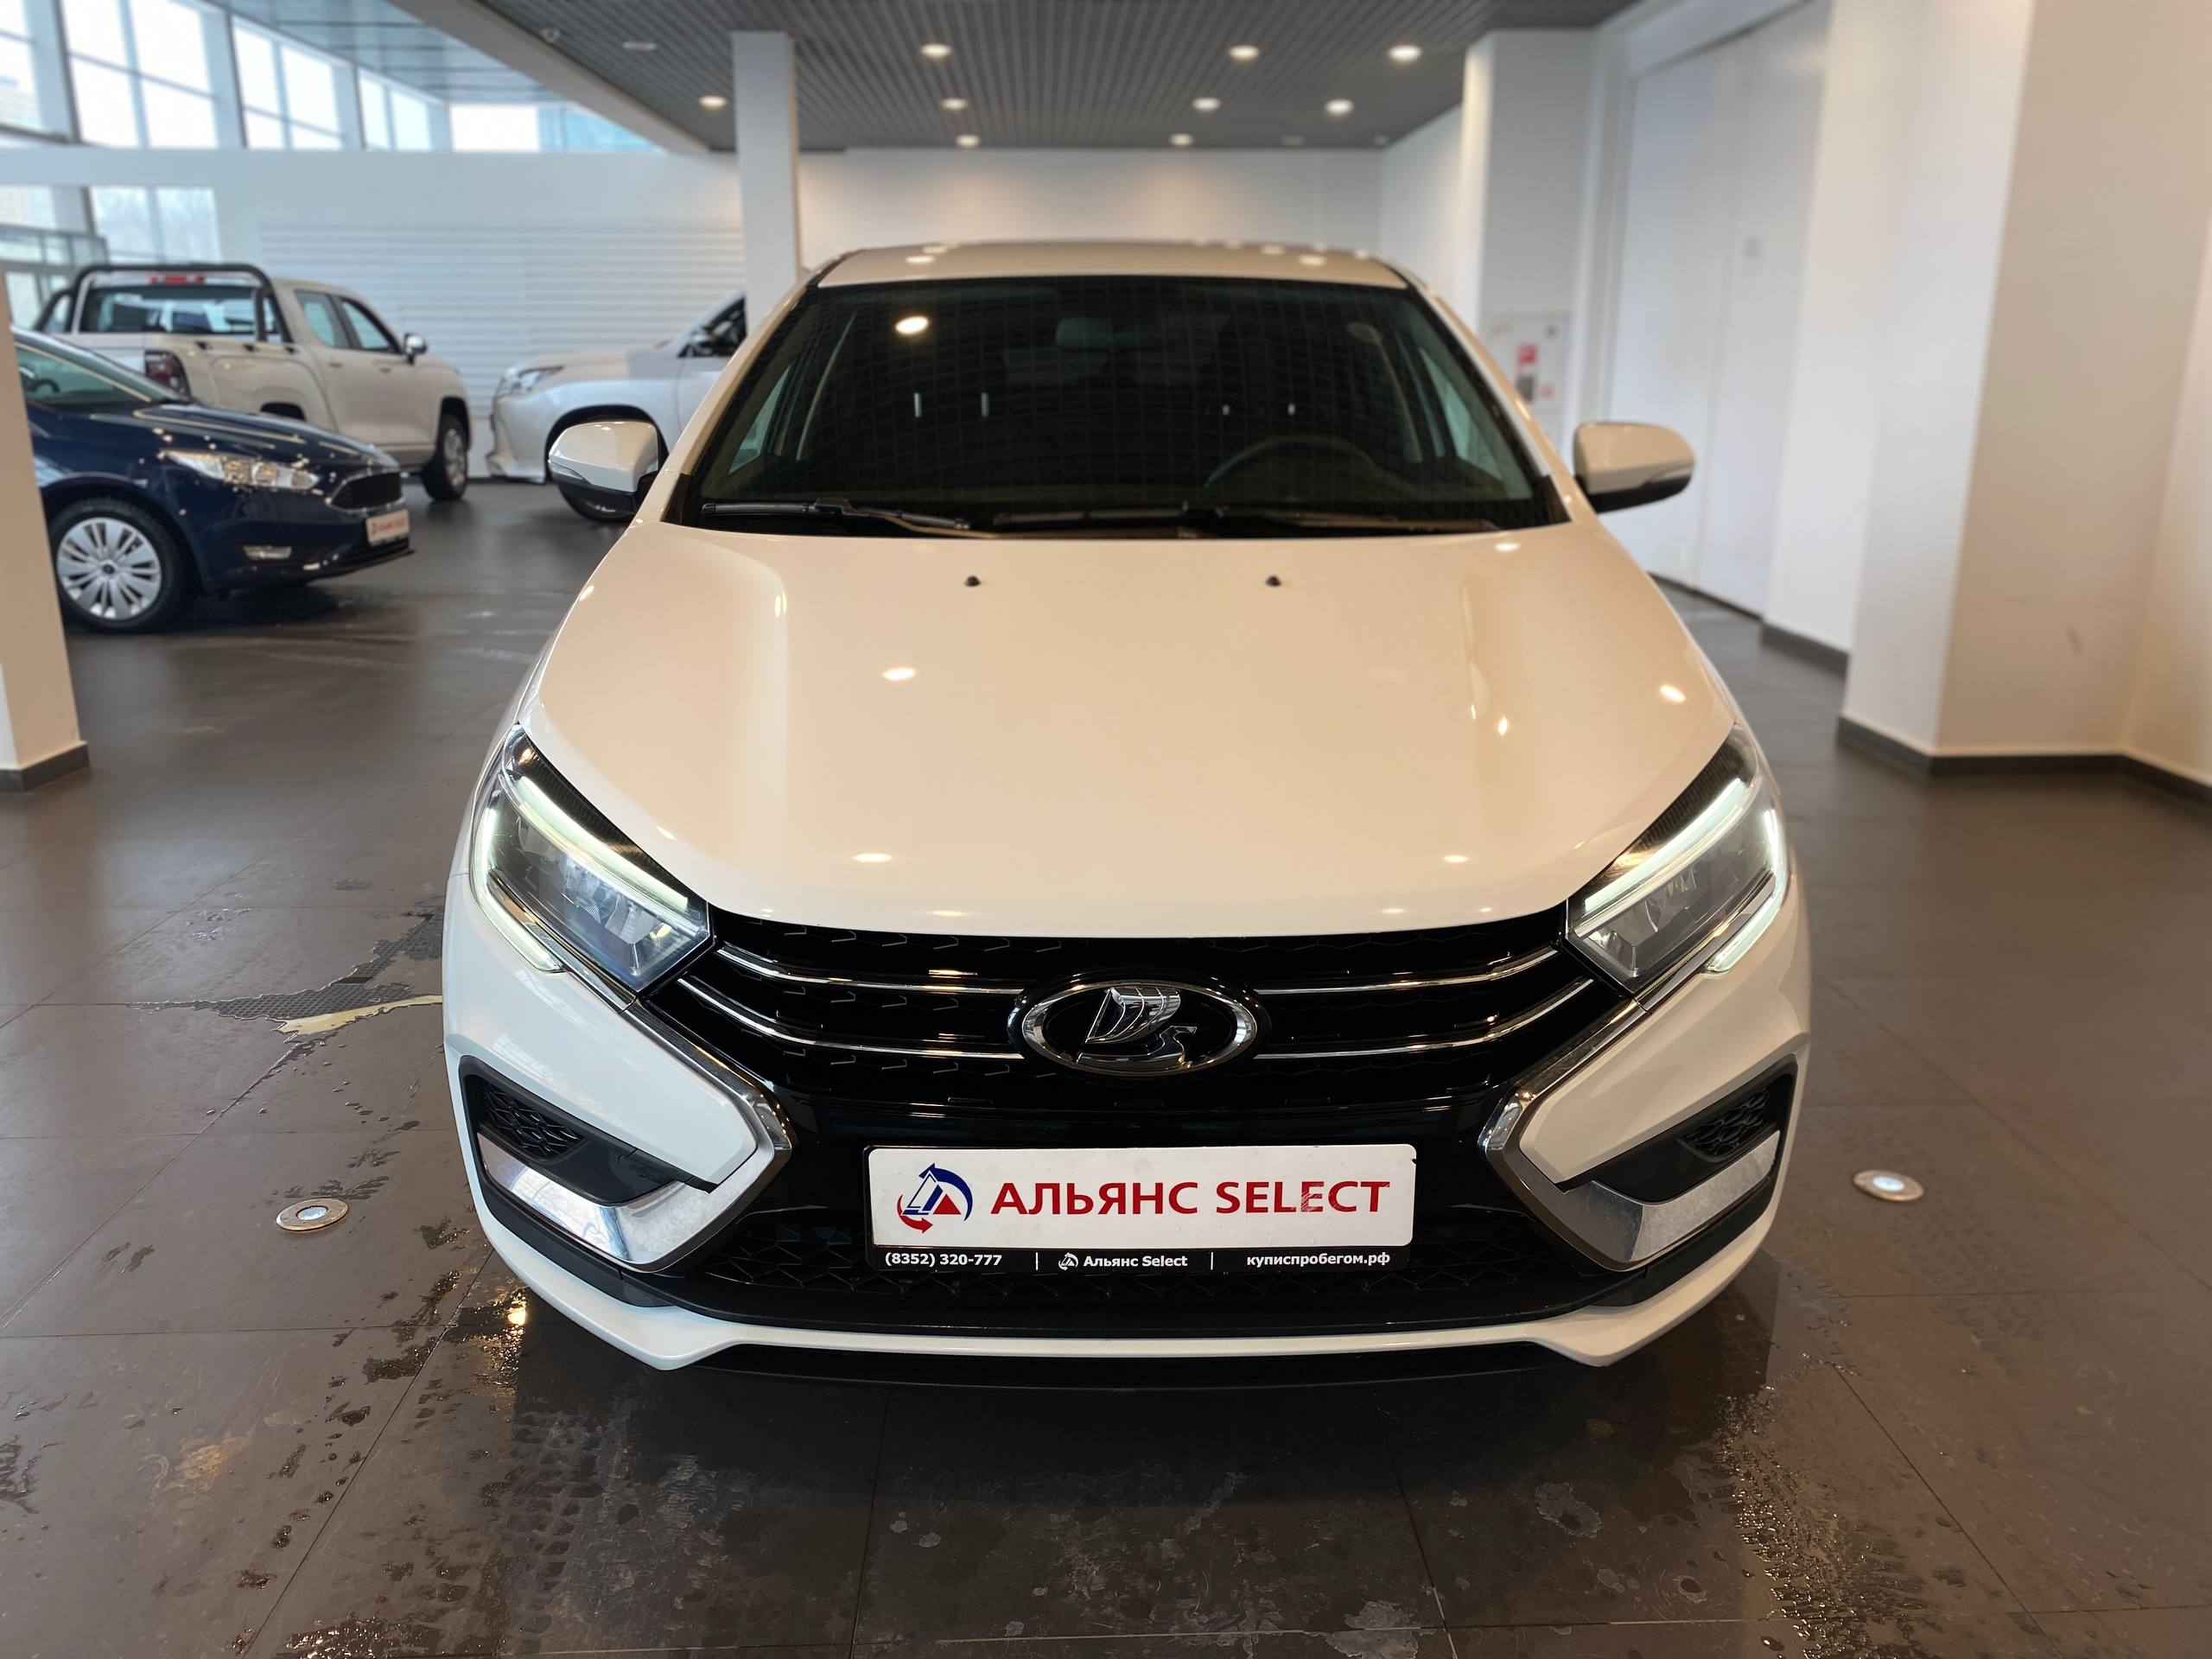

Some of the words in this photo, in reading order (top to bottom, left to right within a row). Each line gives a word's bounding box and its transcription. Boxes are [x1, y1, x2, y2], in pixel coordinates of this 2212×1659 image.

[990, 1181, 1198, 1216] АЛЬЯНС
[1216, 1180, 1391, 1214] SELECT
[885, 1252, 936, 1268] (8352)
[939, 1253, 1002, 1266] 320-777
[1083, 1255, 1139, 1267] Альянс
[1141, 1255, 1188, 1268] Select
[1247, 1251, 1391, 1268] куписпробегом.рф
